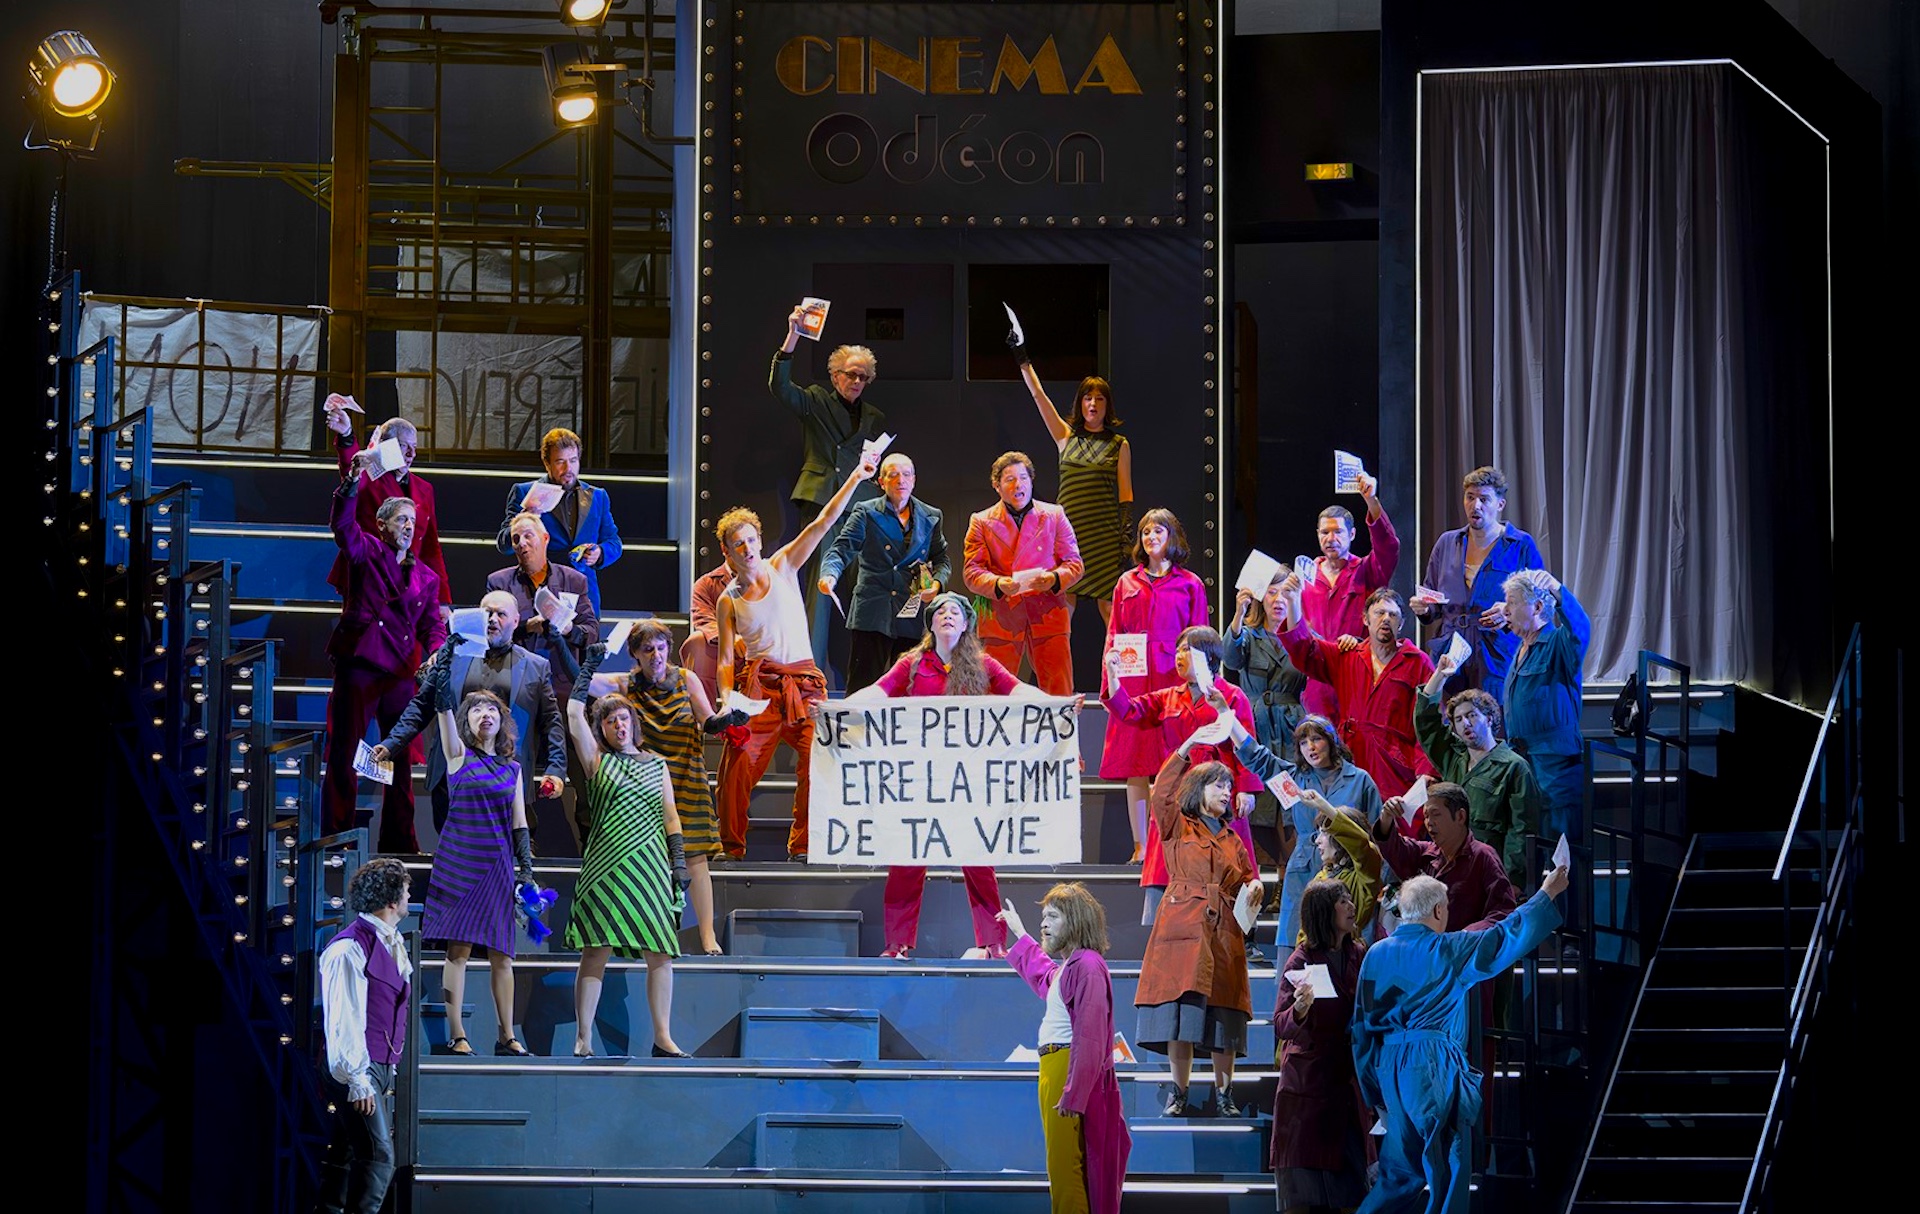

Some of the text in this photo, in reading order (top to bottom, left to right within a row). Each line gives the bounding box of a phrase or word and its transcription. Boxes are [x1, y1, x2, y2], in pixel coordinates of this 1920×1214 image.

[776, 32, 1144, 97] CINEMA
[807, 112, 1105, 185] Odéon
[817, 704, 1075, 749] JE NE PEUX PAS
[841, 758, 1075, 806] ETRE LA FEMME
[827, 816, 1040, 859] DE TA VIE
